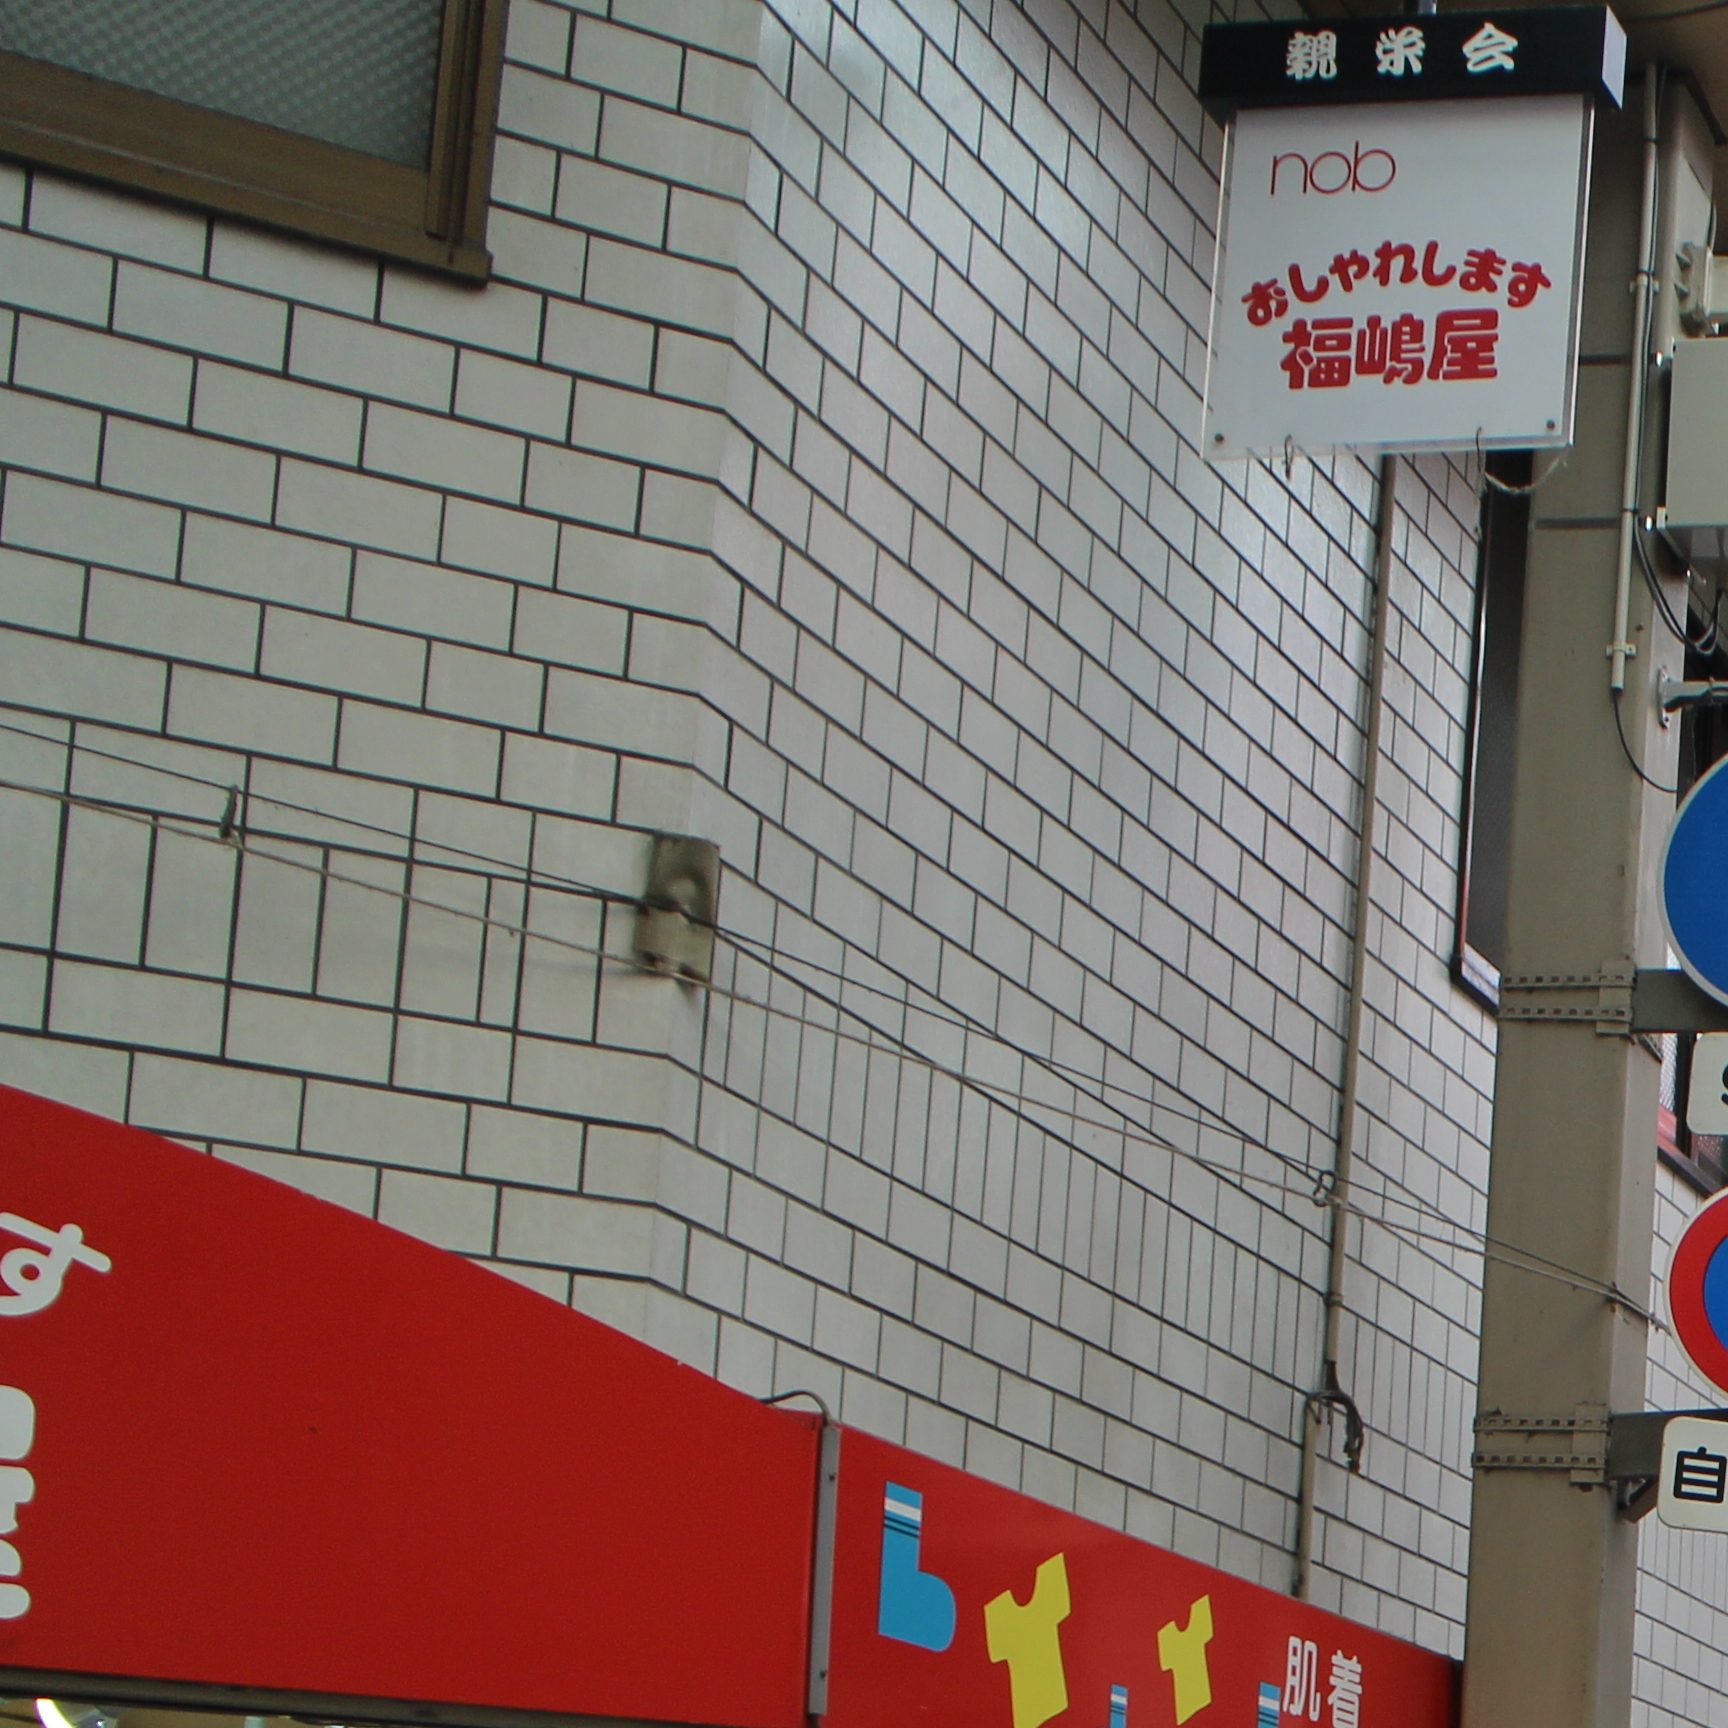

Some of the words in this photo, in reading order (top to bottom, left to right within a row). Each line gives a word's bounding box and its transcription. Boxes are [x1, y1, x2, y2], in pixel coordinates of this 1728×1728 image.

[1285, 23, 1518, 80] 親栄会
[1271, 141, 1397, 196] nob
[1240, 239, 1552, 328] おしゃれします
[1280, 308, 1500, 390] 福嶋屋
